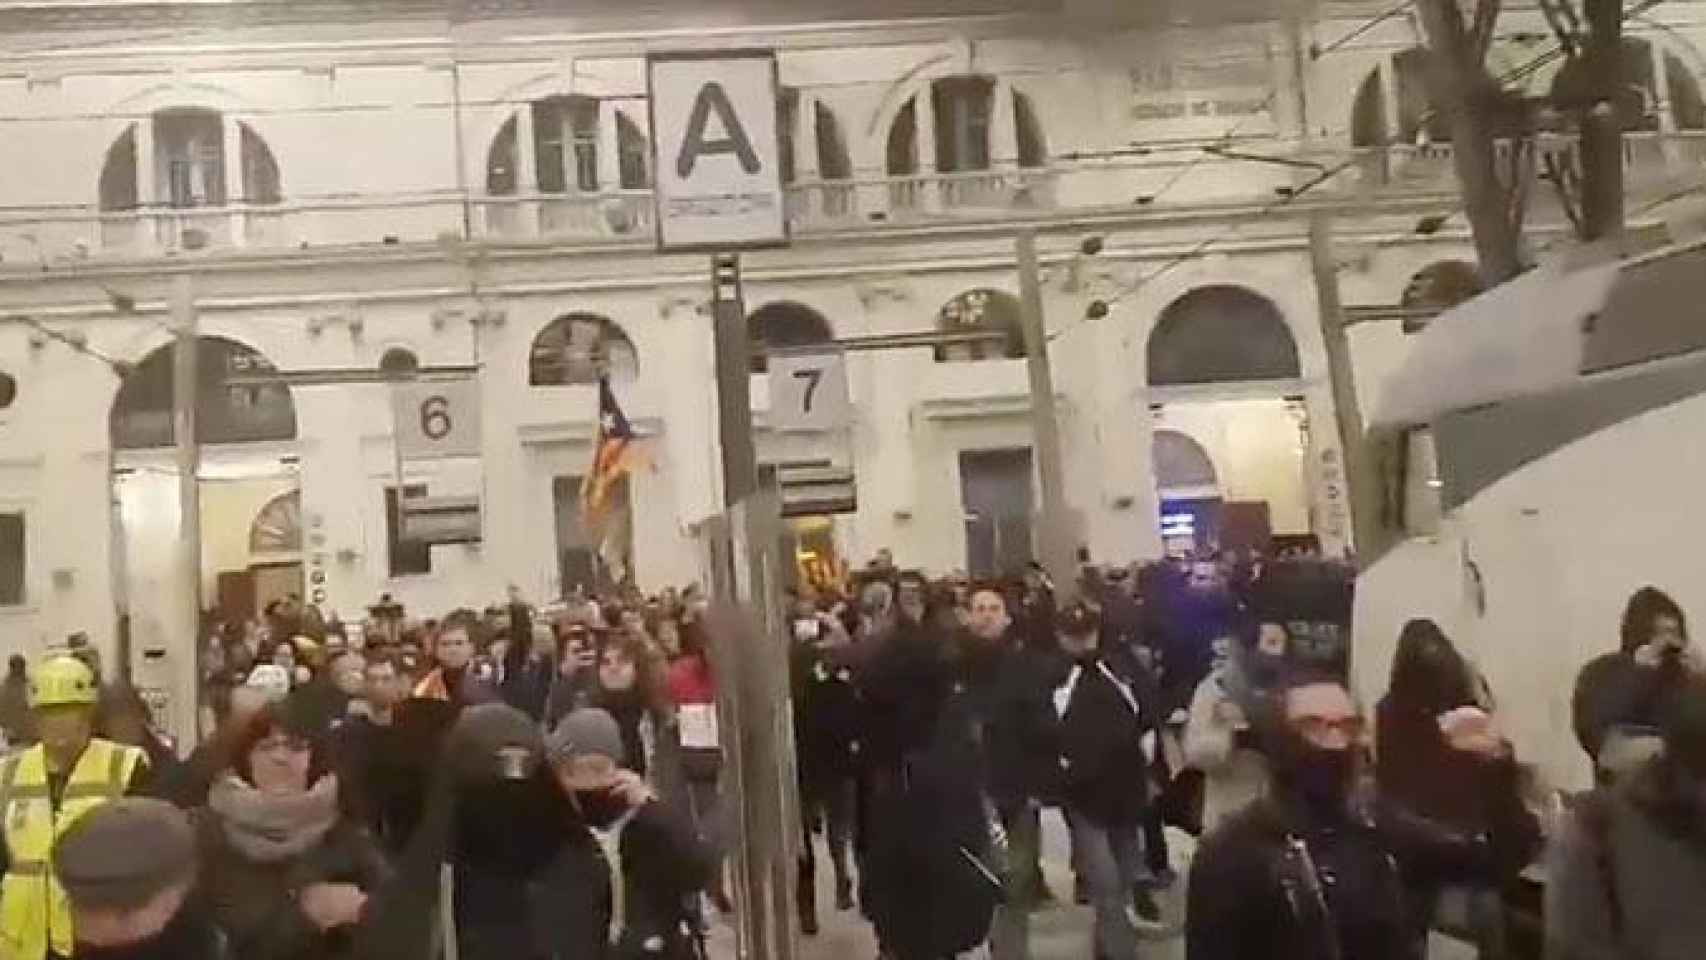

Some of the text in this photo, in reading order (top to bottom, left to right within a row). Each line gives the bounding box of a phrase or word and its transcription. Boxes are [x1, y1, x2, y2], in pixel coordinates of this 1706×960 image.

[677, 81, 762, 179] A
[792, 370, 822, 413] 7
[421, 395, 451, 441] 6
